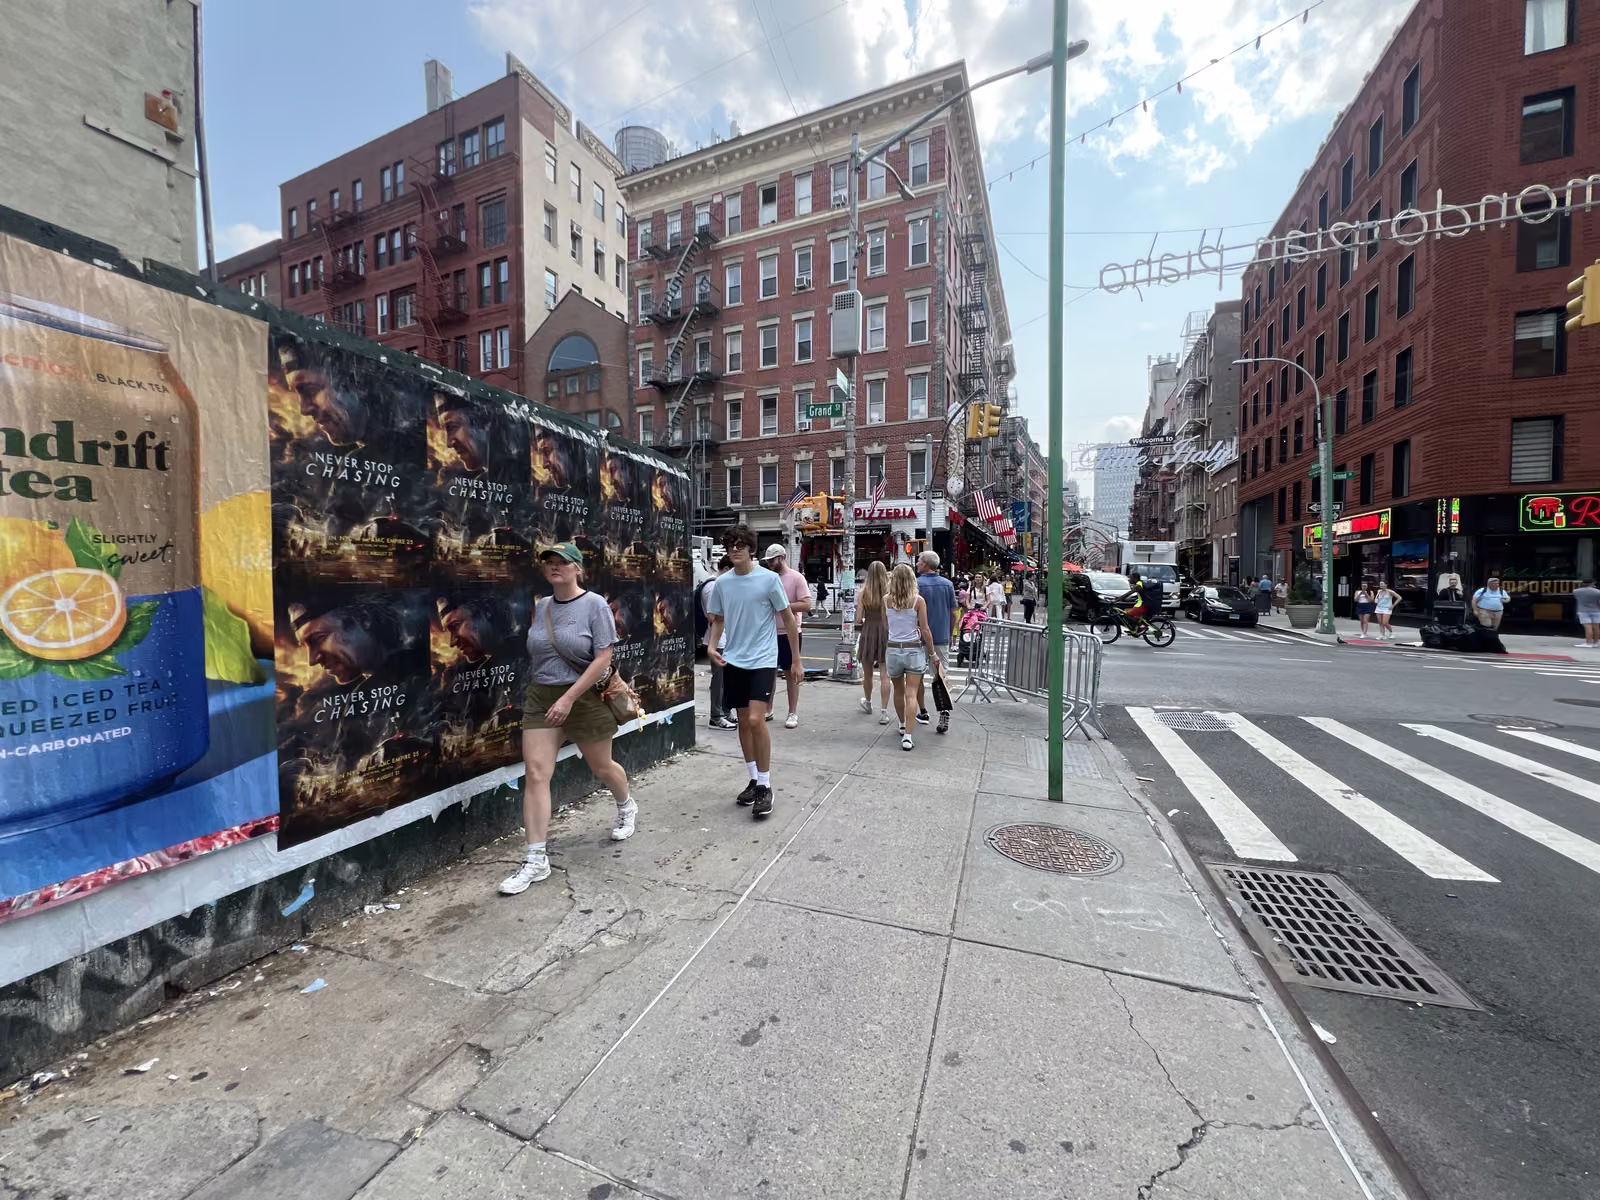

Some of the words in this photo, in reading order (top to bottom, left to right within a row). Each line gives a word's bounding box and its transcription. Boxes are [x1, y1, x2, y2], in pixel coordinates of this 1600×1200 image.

[96, 373, 148, 391] BLACK
[149, 382, 170, 394] TEA
[809, 404, 832, 416] Grand
[1132, 436, 1164, 444] Welcome
[1152, 435, 1233, 472] Italy
[315, 452, 358, 469] NEVER
[364, 460, 393, 474] STOP
[306, 463, 400, 488] CHASING
[454, 477, 484, 489] NEVER
[488, 481, 508, 492] STOP
[449, 486, 513, 504] CHASING
[548, 492, 568, 503] NEVER
[571, 497, 584, 505] STOP
[544, 500, 588, 516] CHASING
[613, 507, 628, 516] NEVER
[629, 508, 641, 516] STOP
[855, 508, 917, 521] PIZZERIA
[610, 512, 644, 524] CHASING
[660, 522, 685, 532] CHASING
[93, 534, 157, 544] SLIGHTLY
[107, 539, 174, 569] sweet
[660, 642, 686, 652] CHASING
[458, 669, 486, 681] NEVER
[490, 664, 510, 676] STOP
[453, 672, 515, 693] CHASING
[53, 688, 114, 709] ICED
[124, 680, 161, 697] TEA
[323, 691, 365, 708] NEVER
[371, 685, 398, 699] STOP
[0, 708, 117, 738] UEEZED
[128, 693, 179, 716] FRUIT
[314, 694, 406, 723] CHASING
